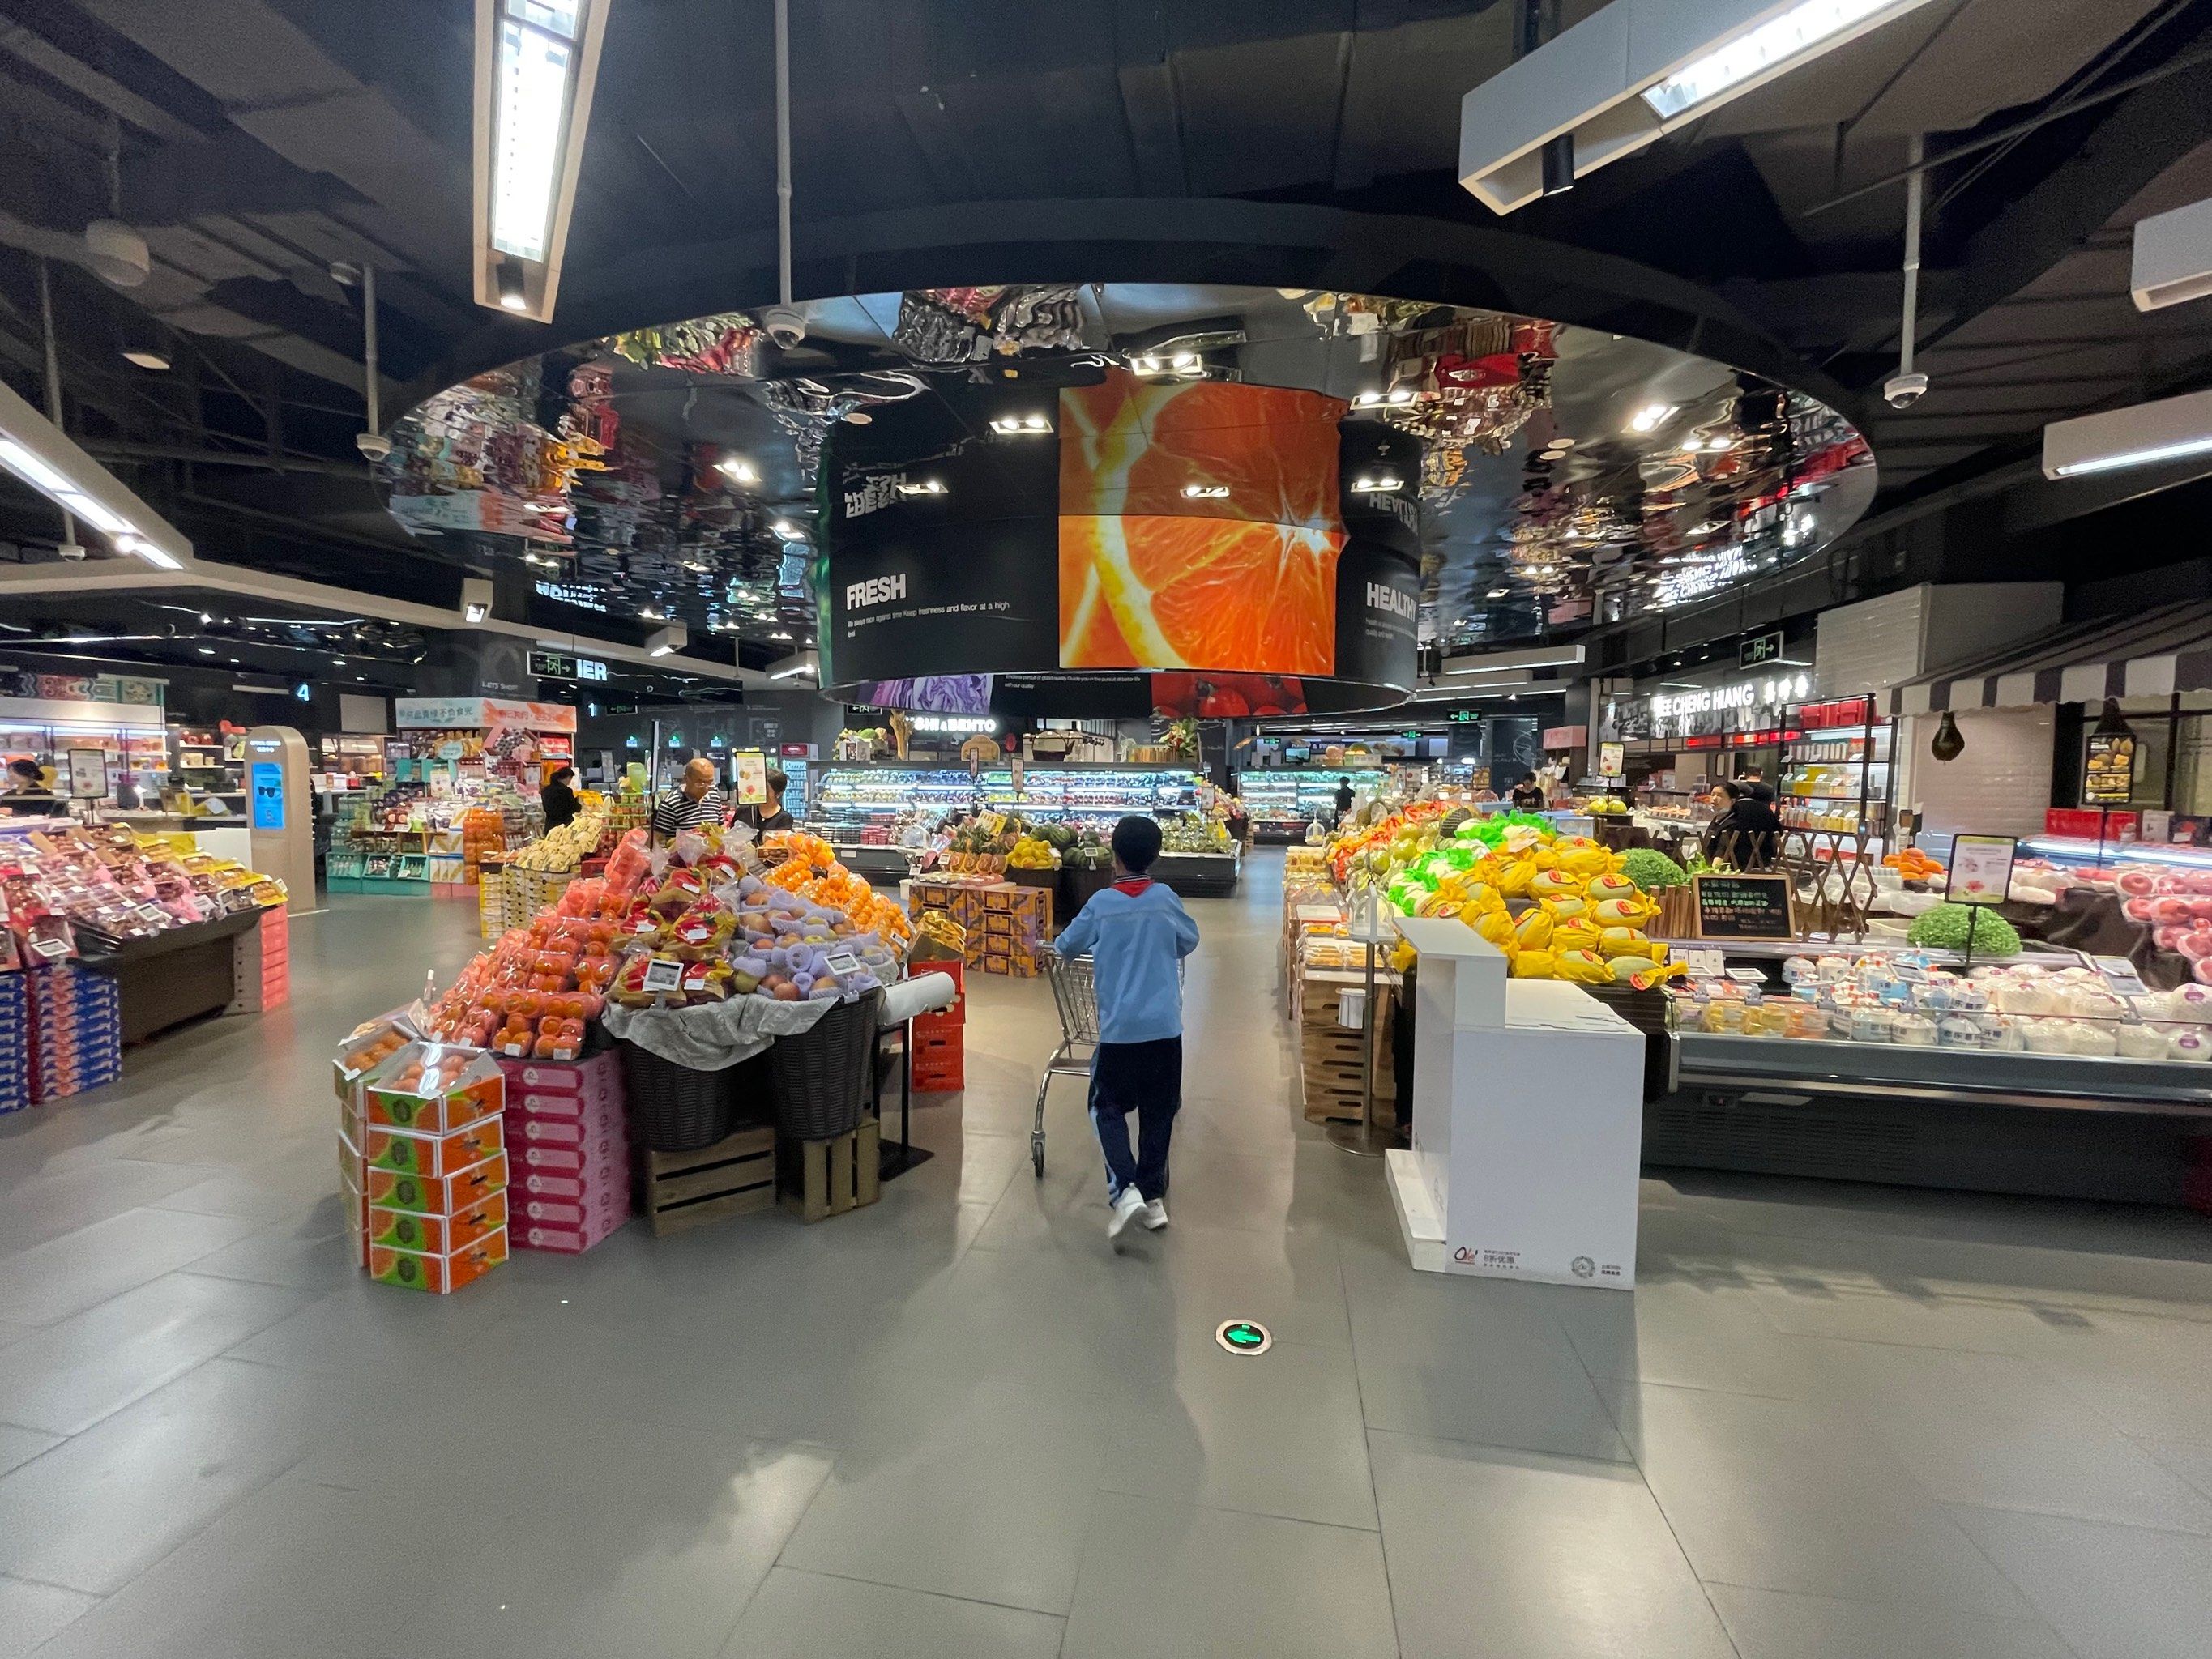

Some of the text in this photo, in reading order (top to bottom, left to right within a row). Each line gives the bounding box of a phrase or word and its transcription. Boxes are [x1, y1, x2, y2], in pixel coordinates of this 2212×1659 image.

[847, 574, 907, 610] FRESH
[946, 604, 959, 612] and
[960, 603, 978, 612] flavor
[994, 601, 1010, 611] high
[1367, 582, 1416, 622] HEALTHY
[297, 684, 310, 702] 4
[1673, 690, 1710, 714] CHENG
[1713, 684, 1754, 710] HIANG
[588, 702, 596, 717] 1
[948, 718, 997, 732] BENTO
